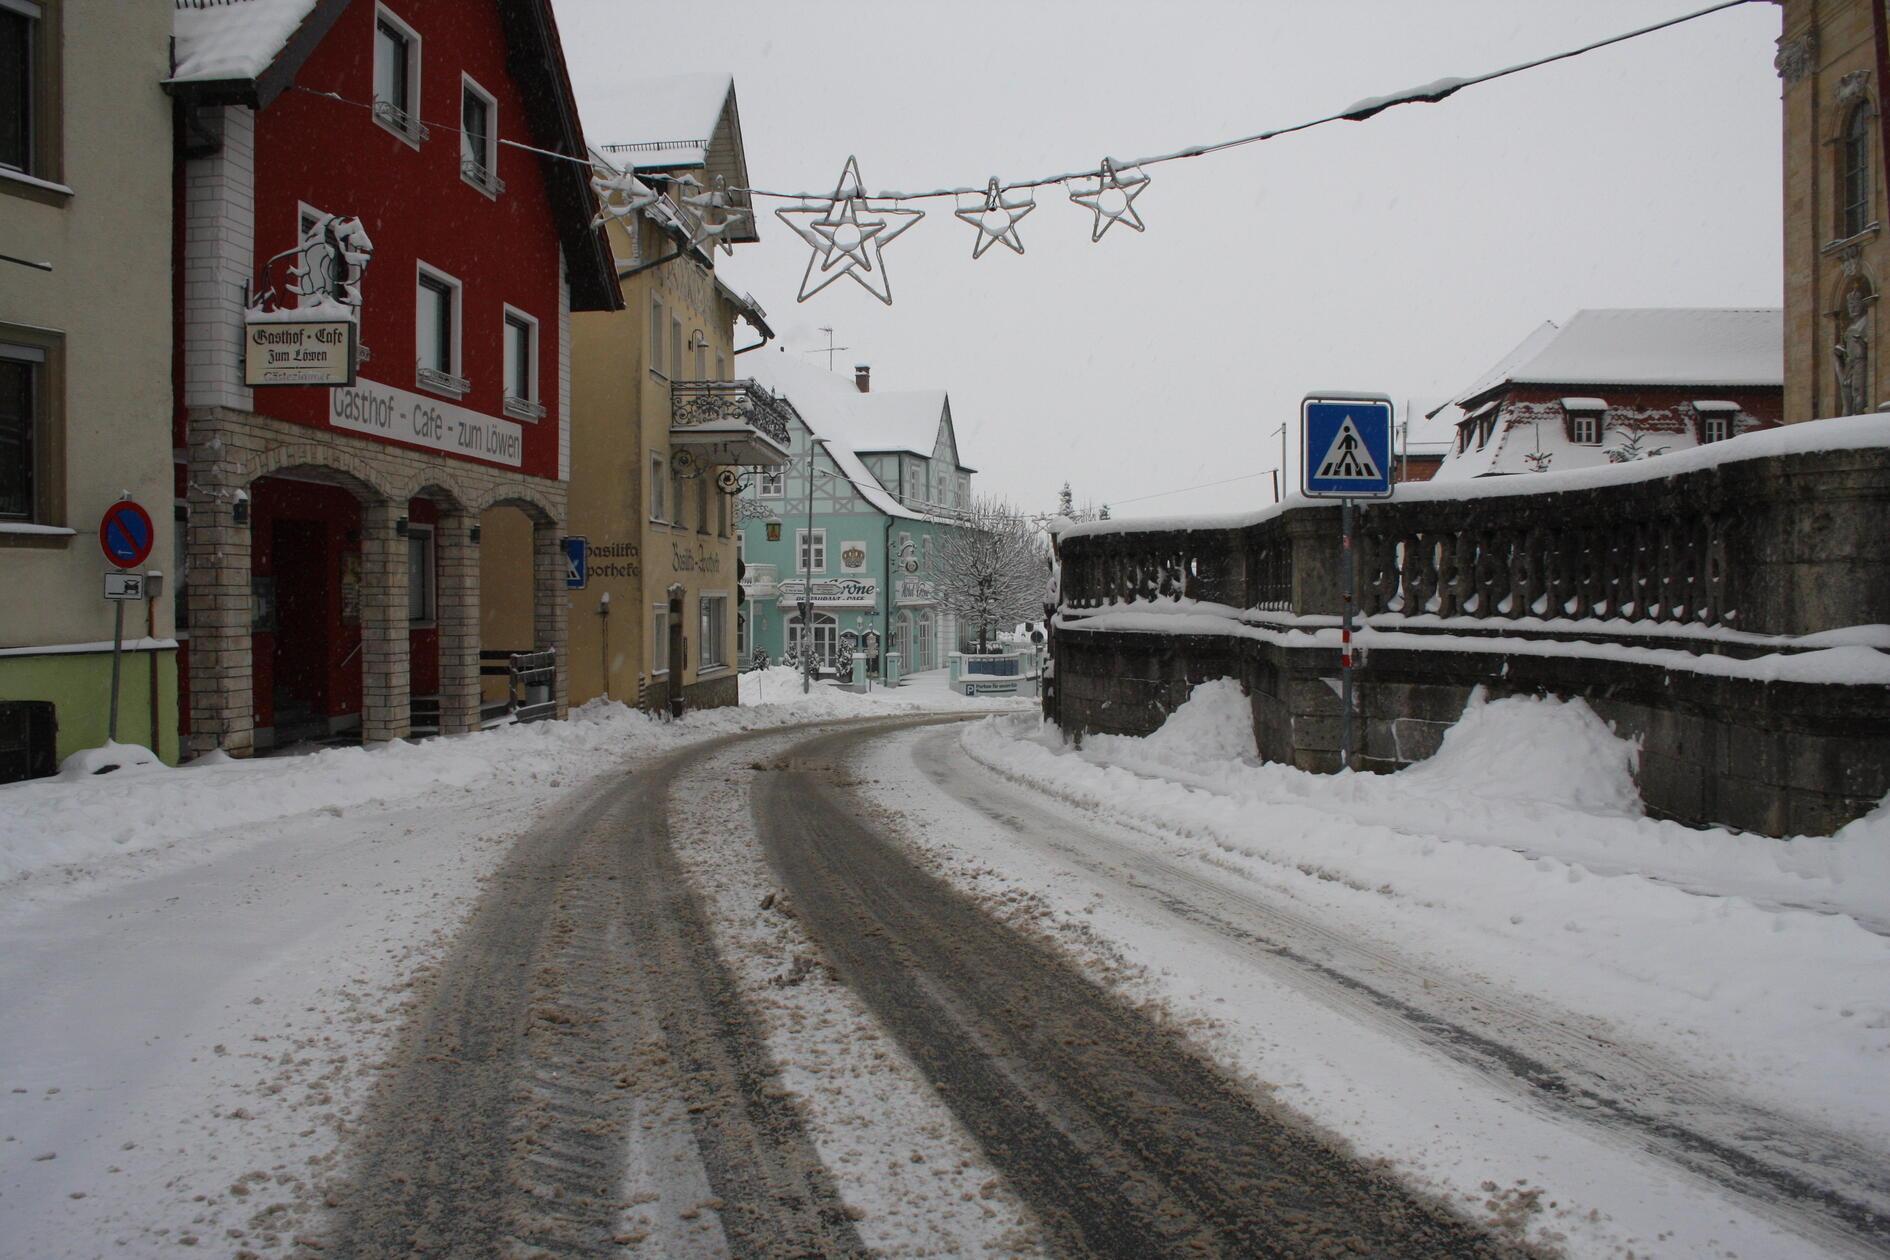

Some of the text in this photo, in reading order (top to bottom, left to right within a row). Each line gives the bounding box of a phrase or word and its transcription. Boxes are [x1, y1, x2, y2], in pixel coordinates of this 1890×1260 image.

[253, 328, 344, 346] Gasthof Cafe
[268, 348, 327, 364] Zum Löwen
[333, 387, 394, 429] Gasthof
[413, 403, 443, 441] Cafe
[458, 421, 482, 451] zum
[486, 424, 520, 460] Löwen
